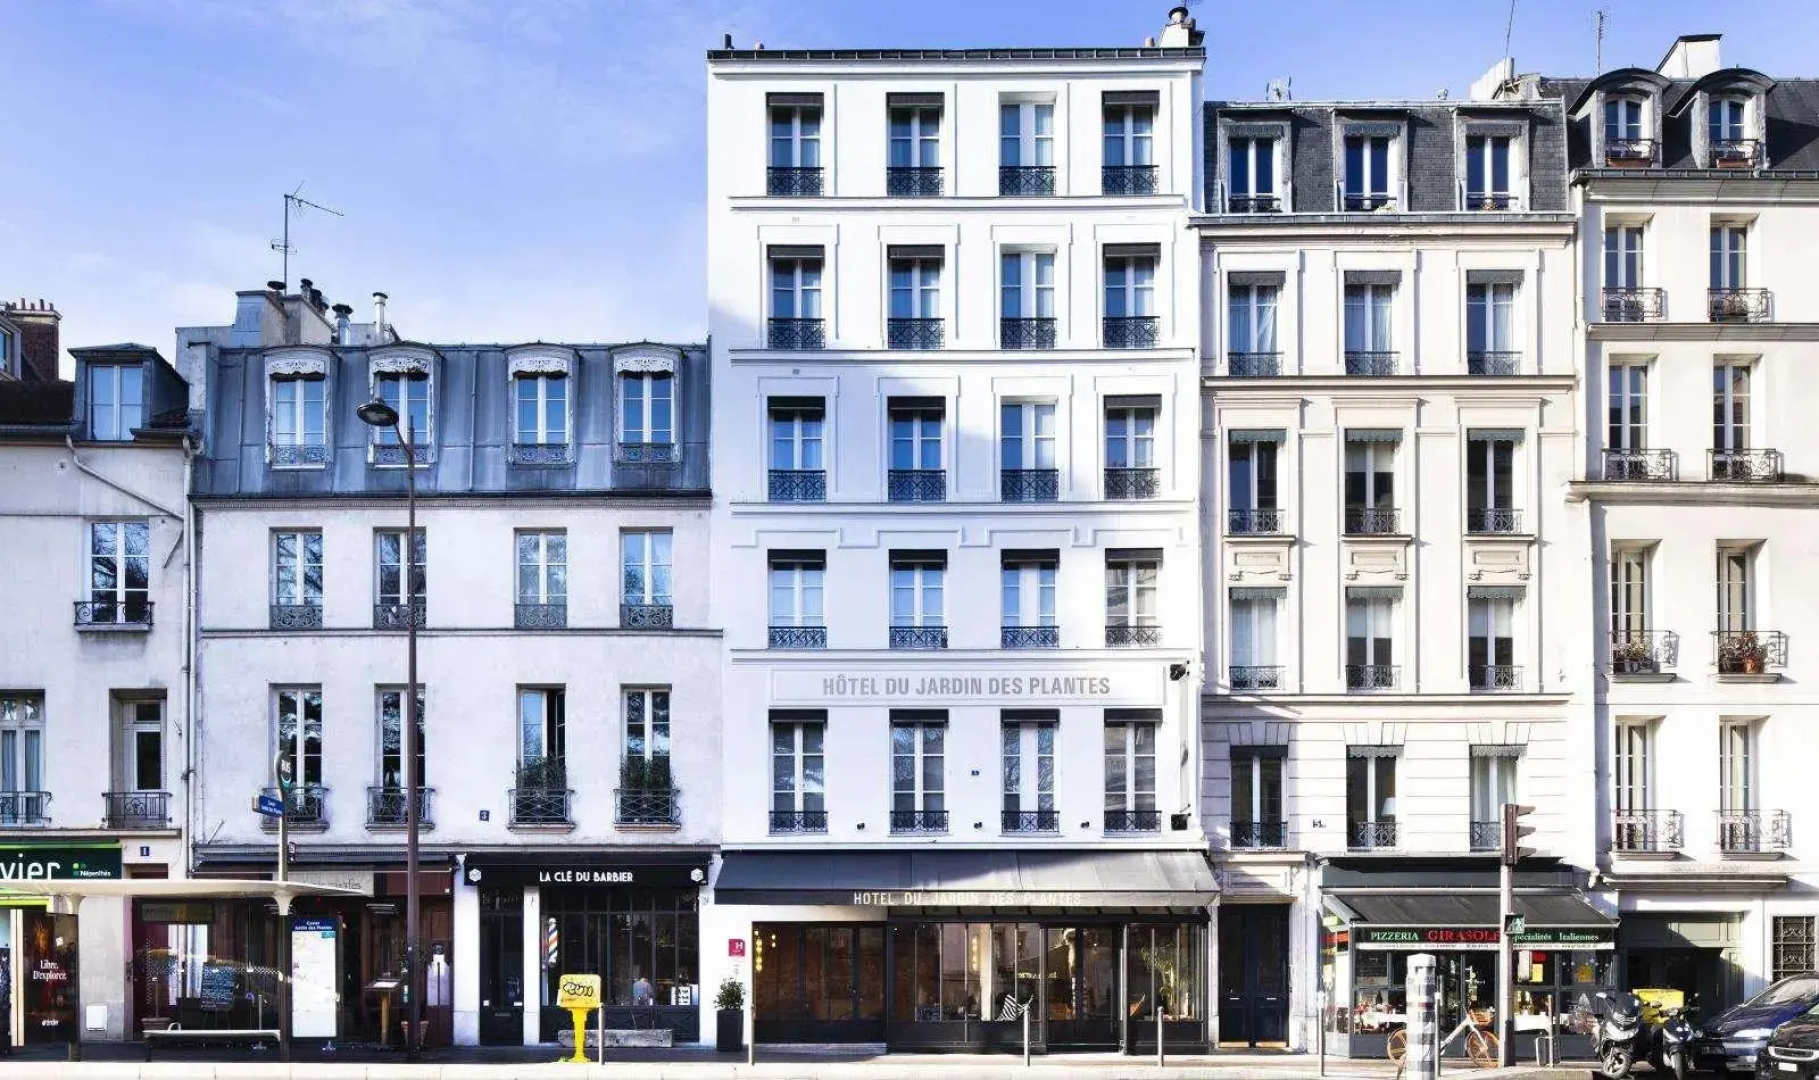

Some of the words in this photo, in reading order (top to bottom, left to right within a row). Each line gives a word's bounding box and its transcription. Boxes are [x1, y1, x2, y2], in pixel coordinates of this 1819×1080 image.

[823, 674, 879, 695] HÔTEL
[885, 678, 909, 695] DU
[916, 678, 982, 695] JARDIN
[988, 677, 1023, 695] DES
[1029, 677, 1111, 695] PLANTES
[539, 871, 551, 882] LA
[575, 871, 590, 882] DU
[593, 871, 633, 882] BARBIER
[854, 891, 894, 905] HOTEL
[904, 892, 921, 905] DU
[989, 892, 1015, 906] DES
[1370, 931, 1419, 941] PIZZERIA
[1559, 932, 1599, 941] Italiennes
